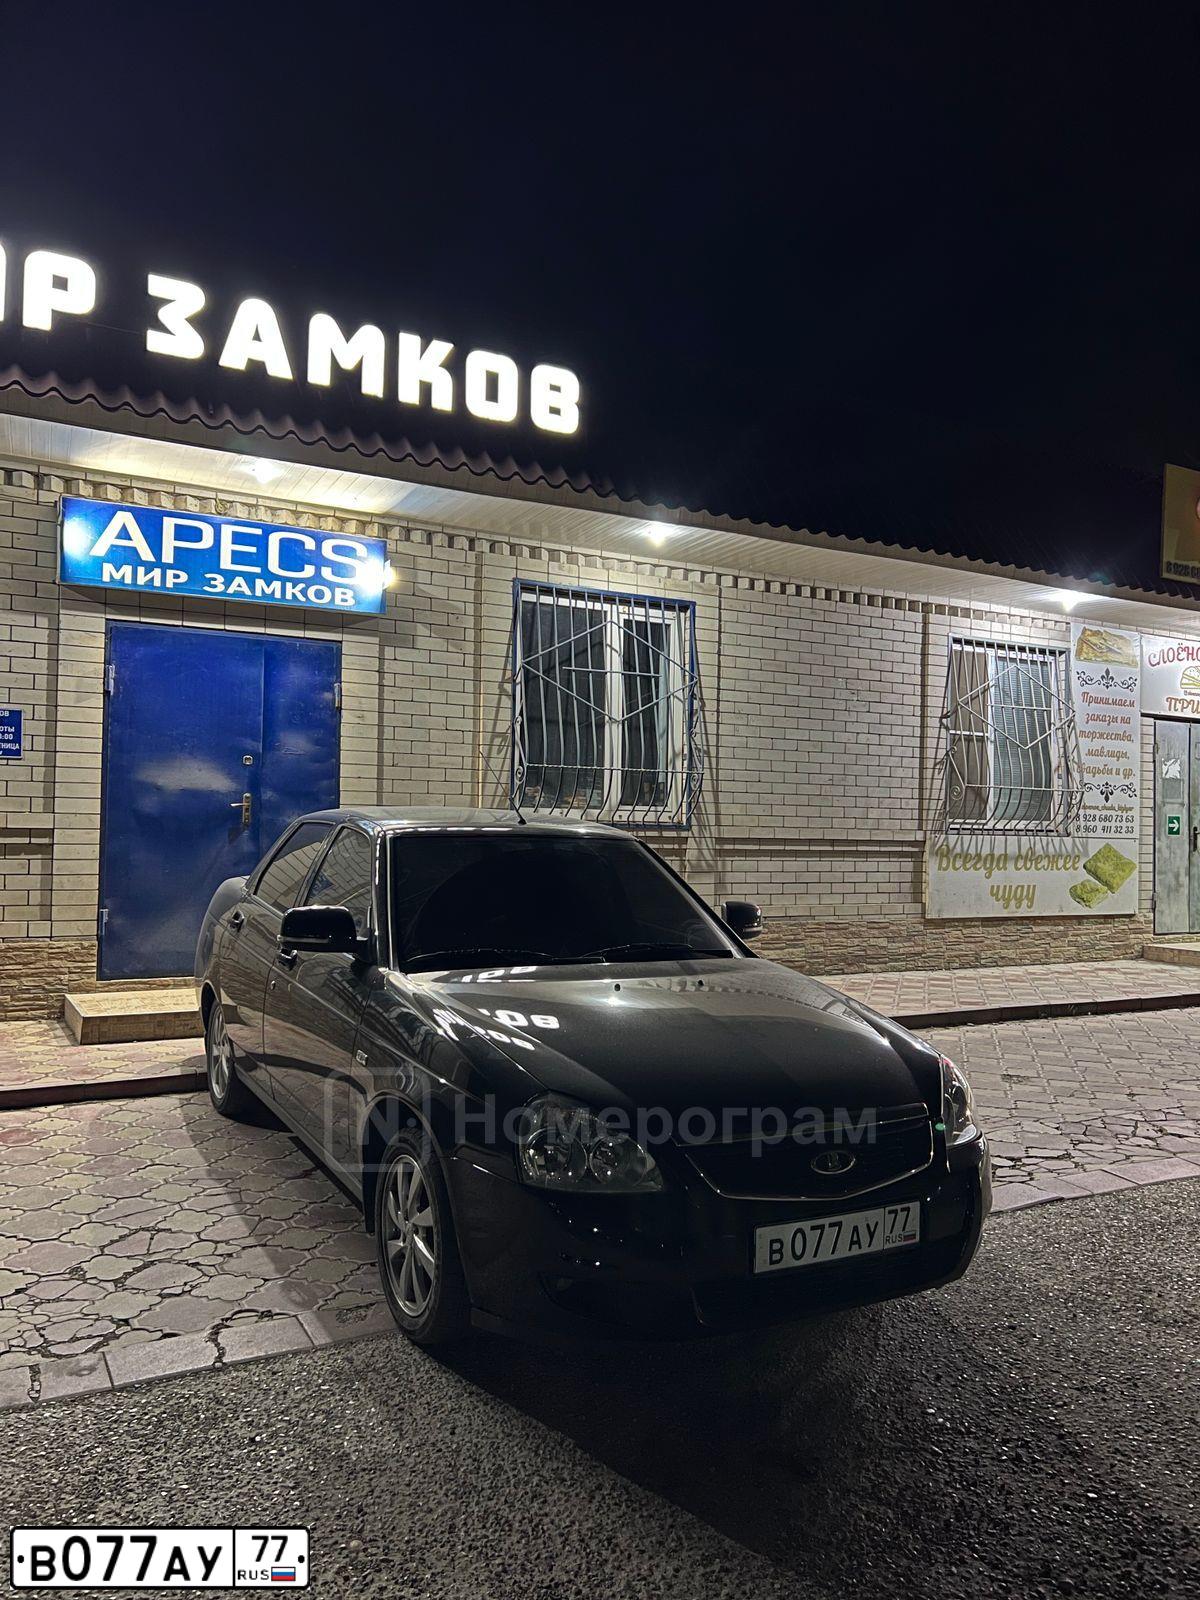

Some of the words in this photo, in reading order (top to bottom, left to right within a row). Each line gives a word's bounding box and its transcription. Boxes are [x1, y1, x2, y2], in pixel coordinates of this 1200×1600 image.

[0, 244, 96, 331] Р
[146, 271, 581, 434] ЗАМКОВ
[89, 511, 370, 585] APECS
[102, 563, 188, 588] МИР
[202, 573, 356, 606] ЗАМКОВ
[1081, 692, 1135, 707] Принимаем
[1085, 713, 1118, 726] заказы
[1120, 716, 1131, 725] на
[1079, 730, 1134, 743] торжества,
[1085, 746, 1130, 761] мавлиды,
[1115, 768, 1121, 776] и
[1122, 768, 1136, 779] др.
[1082, 813, 1097, 822] 928
[1098, 814, 1113, 823] 680
[1114, 814, 1124, 823] 73
[1125, 815, 1135, 823] 63
[1075, 824, 1081, 833] 8
[1082, 824, 1098, 833] 960
[1101, 825, 1112, 834] 411
[1113, 825, 1123, 834] 32
[1124, 825, 1135, 834] 33
[935, 844, 1008, 879] Всегда
[1013, 847, 1081, 872] свежее
[989, 884, 1037, 910] чуду
[887, 1206, 911, 1234] 77
[885, 1233, 903, 1244] RUS
